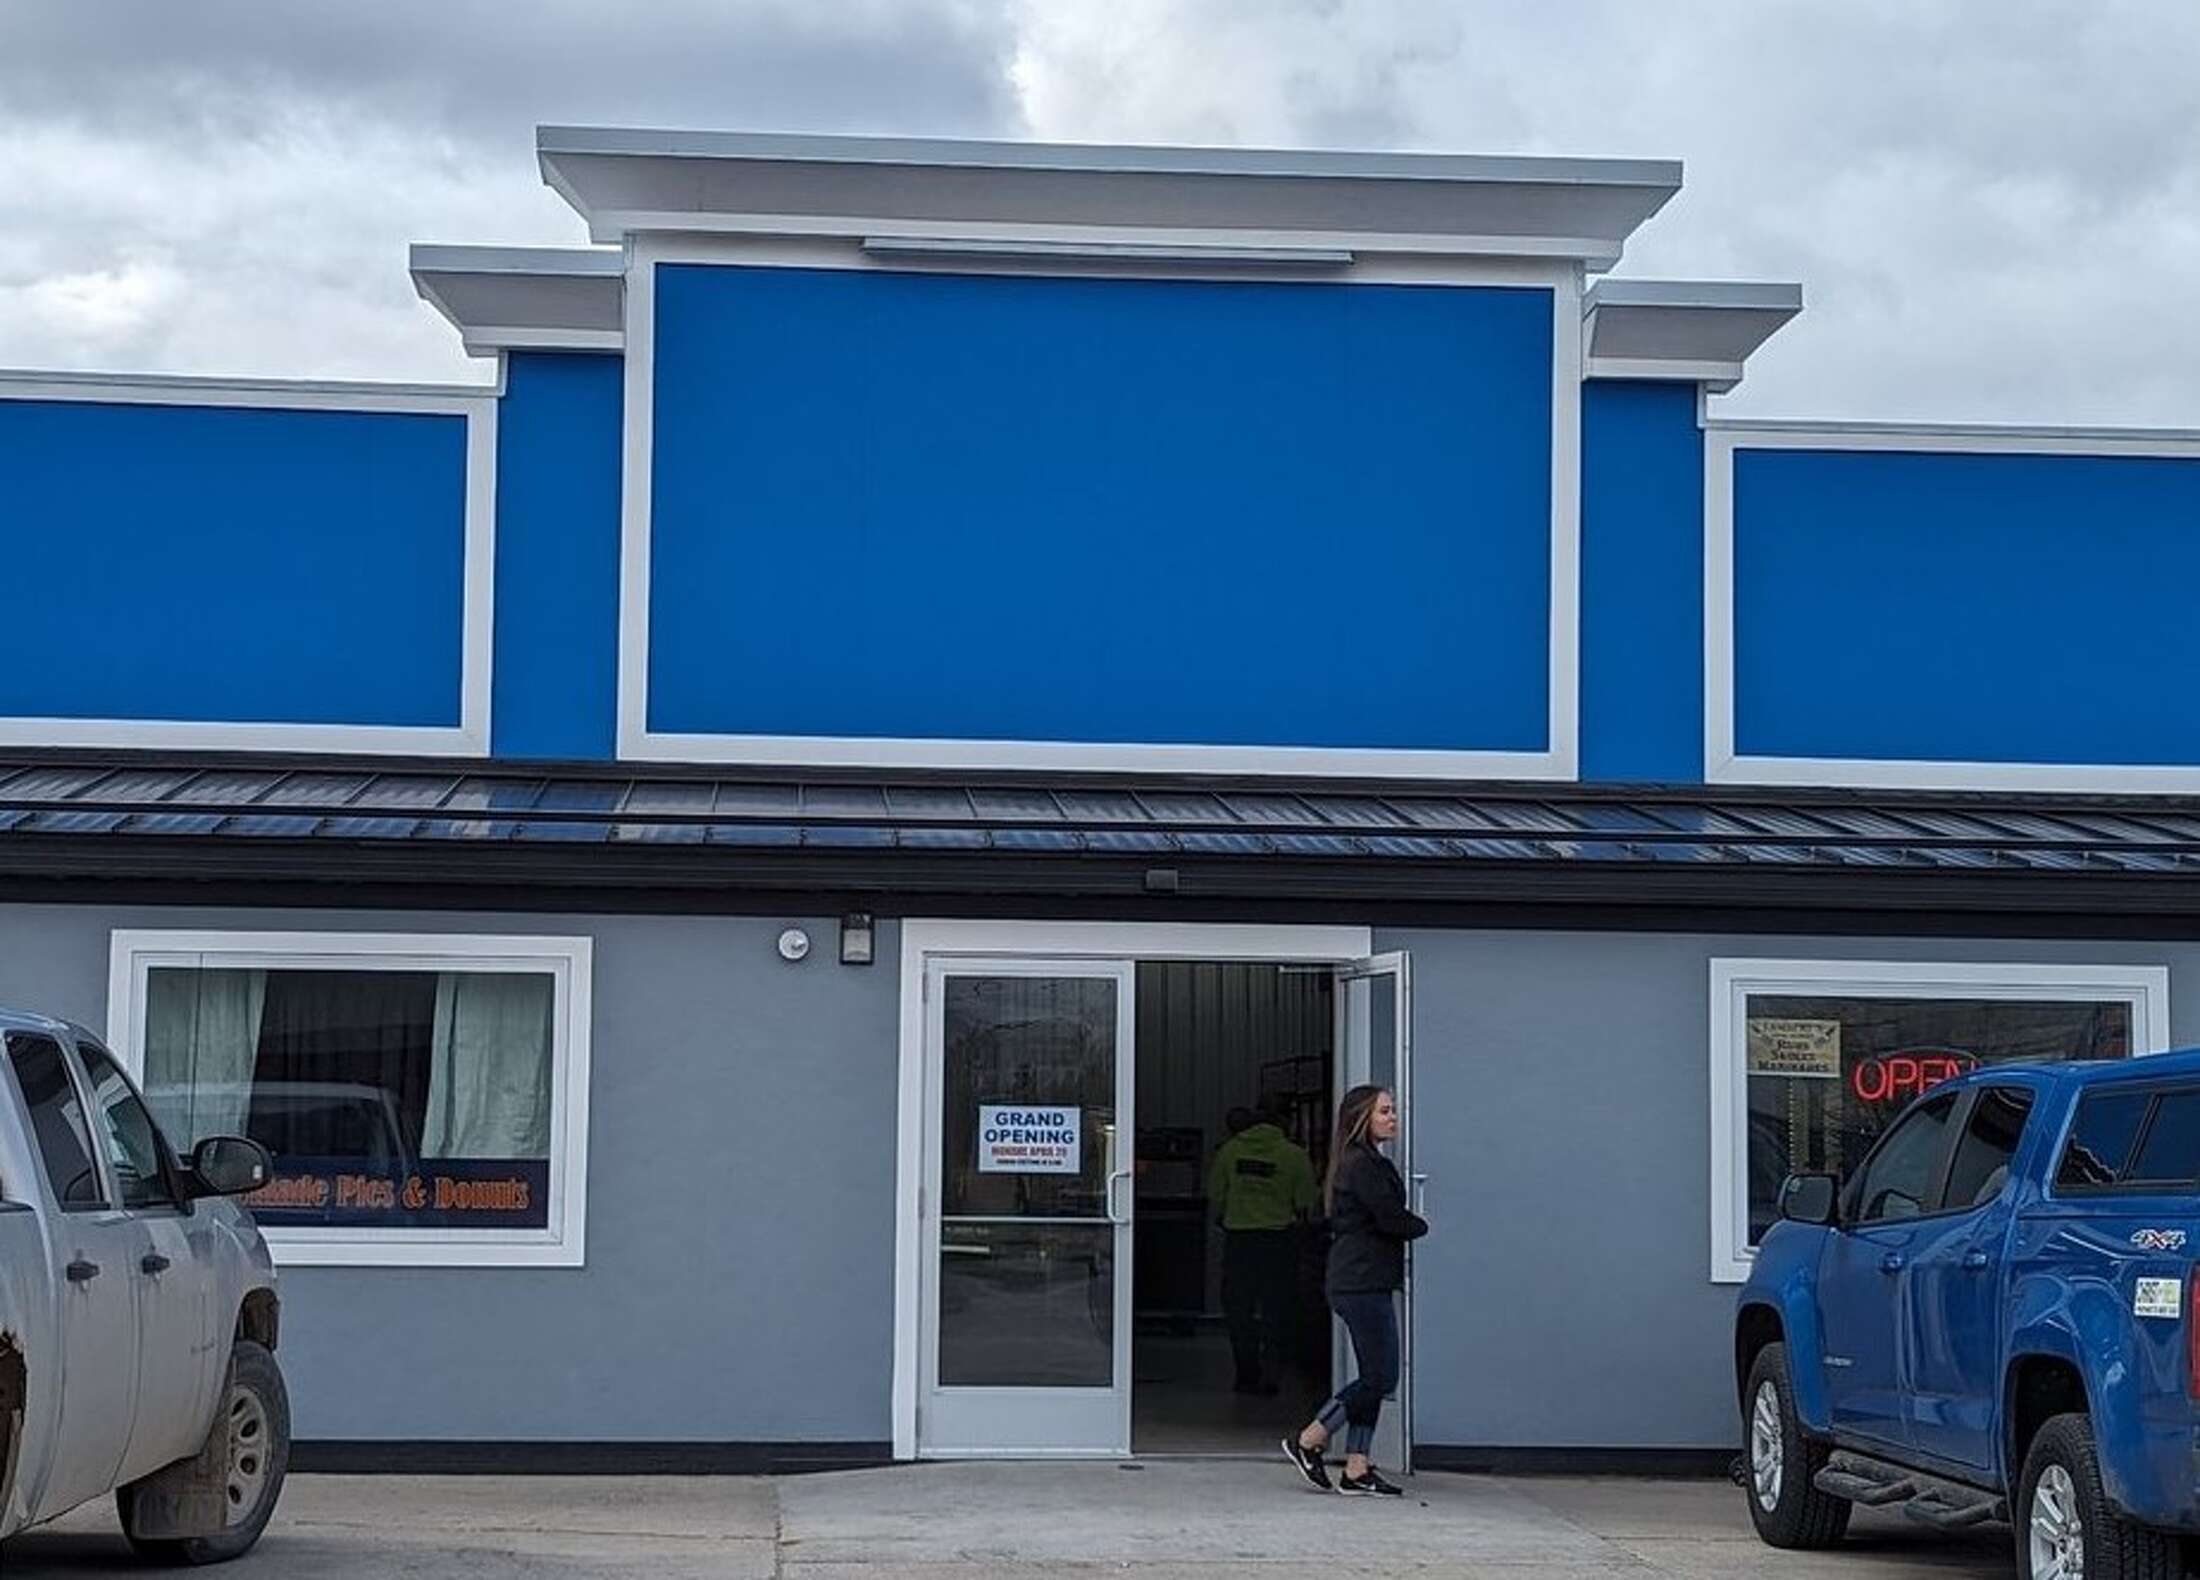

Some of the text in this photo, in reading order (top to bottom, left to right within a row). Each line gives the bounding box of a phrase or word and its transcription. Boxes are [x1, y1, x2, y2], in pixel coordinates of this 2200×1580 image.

[995, 1112, 1065, 1126] GRAND
[985, 1129, 1075, 1144] OPENING
[336, 1175, 395, 1208] Pies
[402, 1176, 427, 1208] &
[433, 1177, 530, 1209] Donuts
